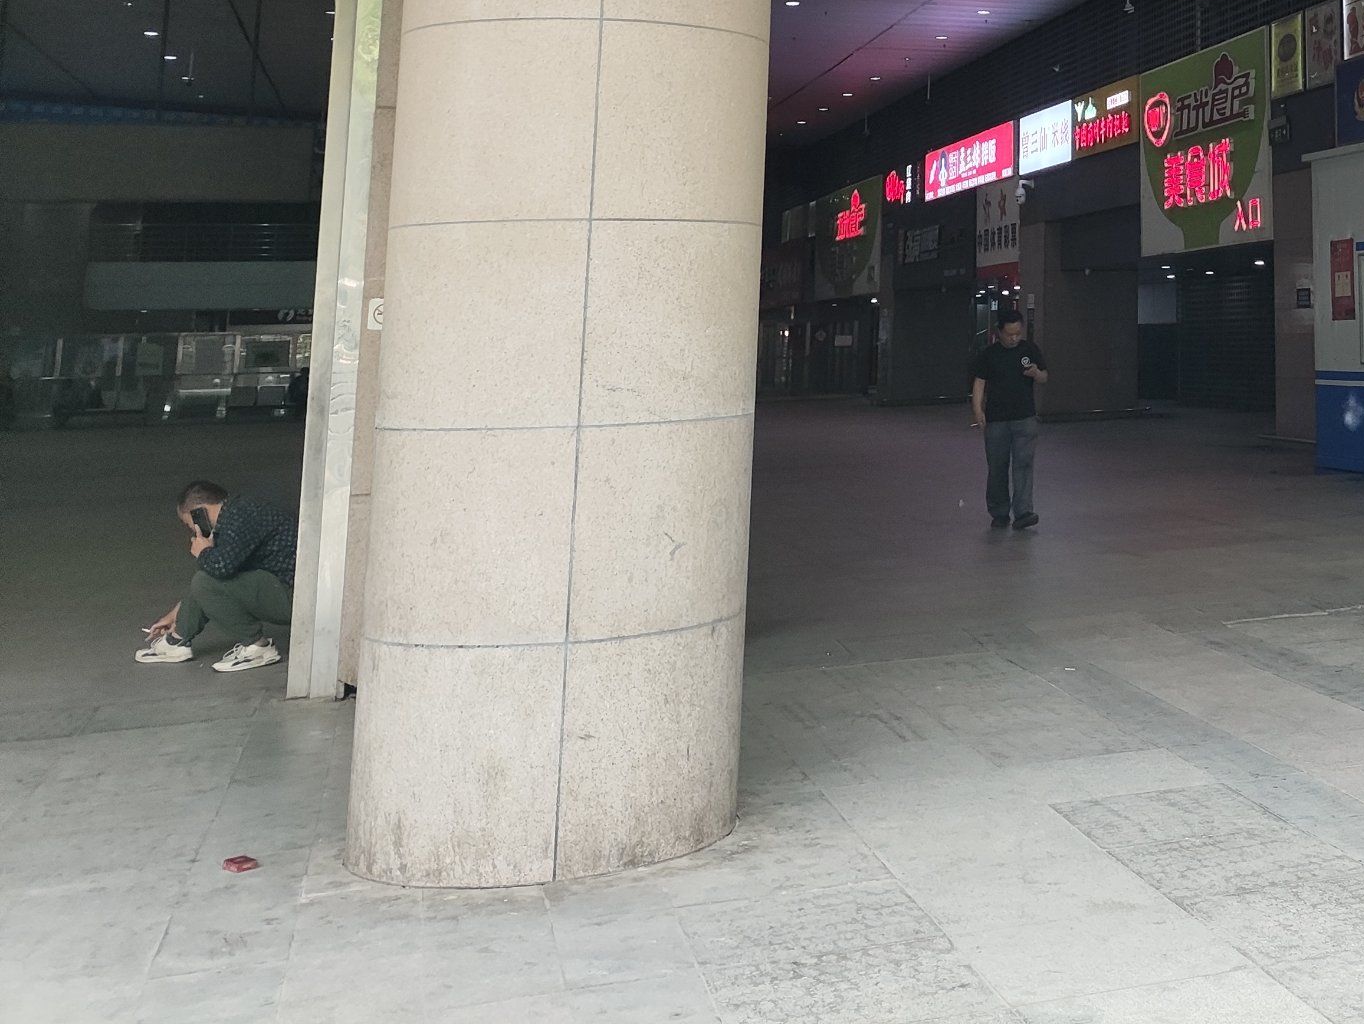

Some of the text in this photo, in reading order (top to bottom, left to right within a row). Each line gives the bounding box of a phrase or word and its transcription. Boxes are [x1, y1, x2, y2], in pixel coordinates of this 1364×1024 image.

[1164, 137, 1234, 210] 美食城
[1234, 197, 1262, 232] 入口
